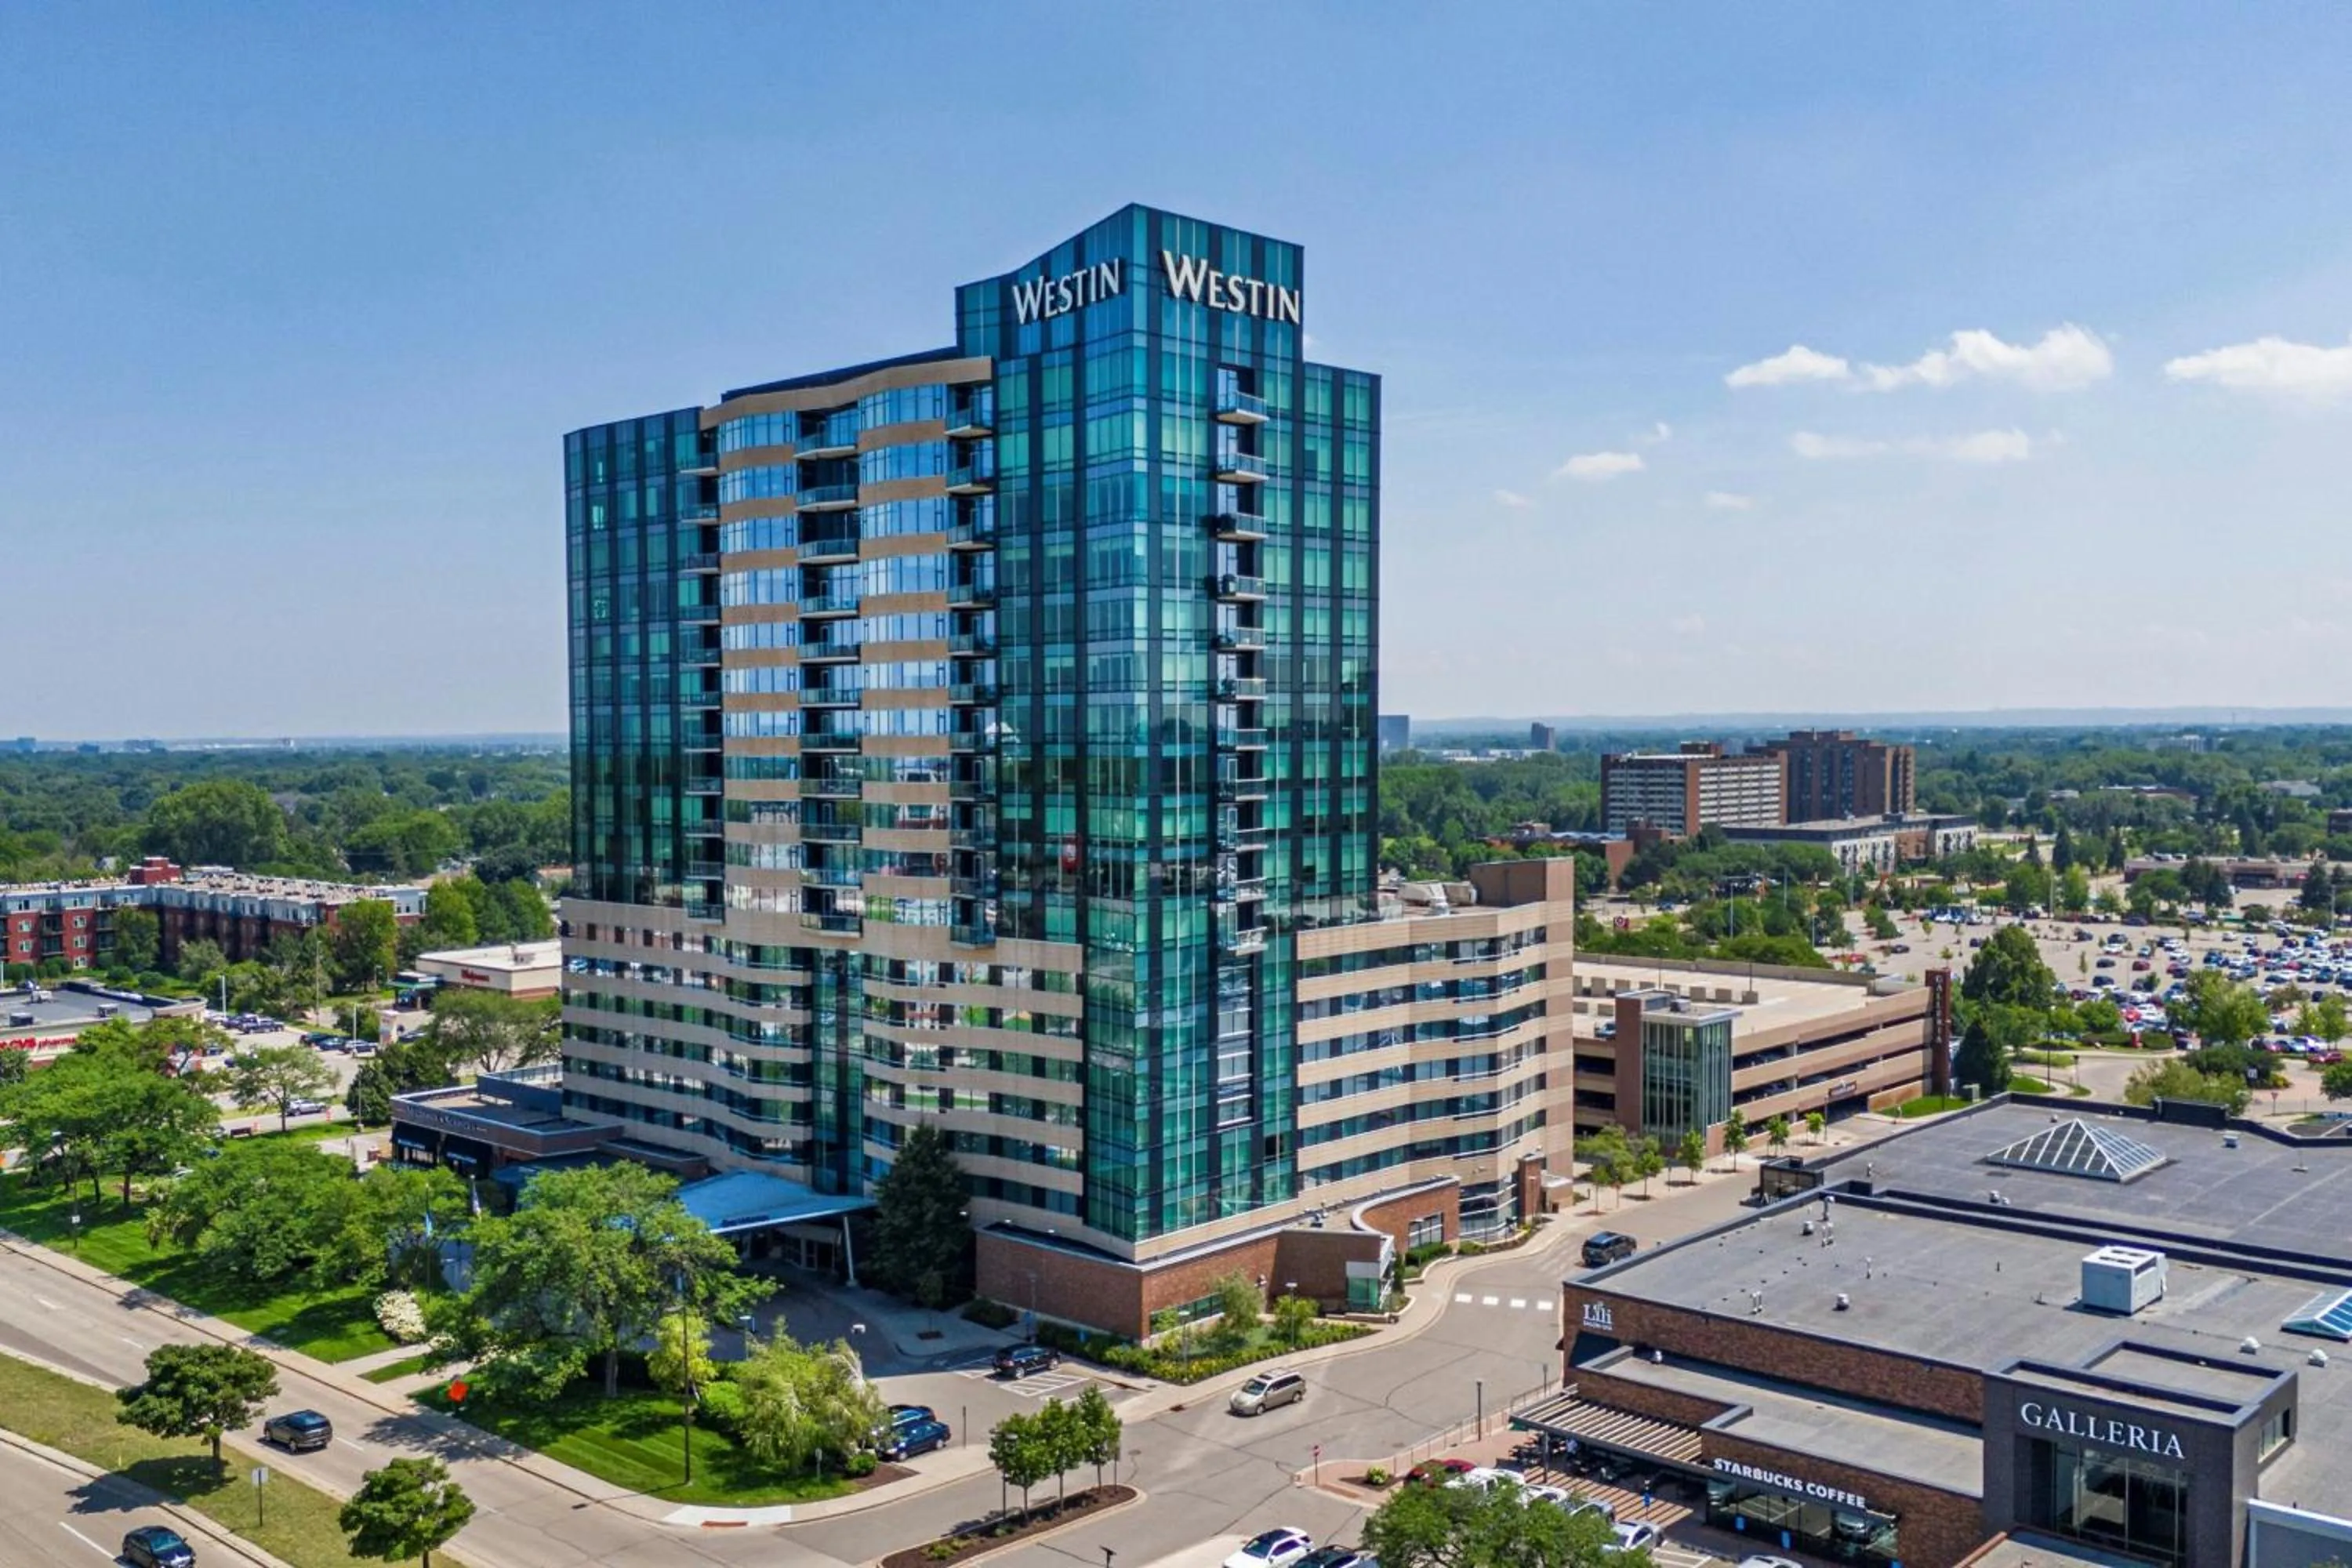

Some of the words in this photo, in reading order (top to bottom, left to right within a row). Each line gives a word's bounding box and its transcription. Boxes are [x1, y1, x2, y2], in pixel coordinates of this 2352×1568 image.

[1013, 257, 1120, 324] WESTIN
[1161, 249, 1301, 325] WESTIN
[2020, 1403, 2185, 1459] GALLERIA
[1713, 1457, 1803, 1491] STARBUCKS
[1806, 1482, 1865, 1508] COFFEE
